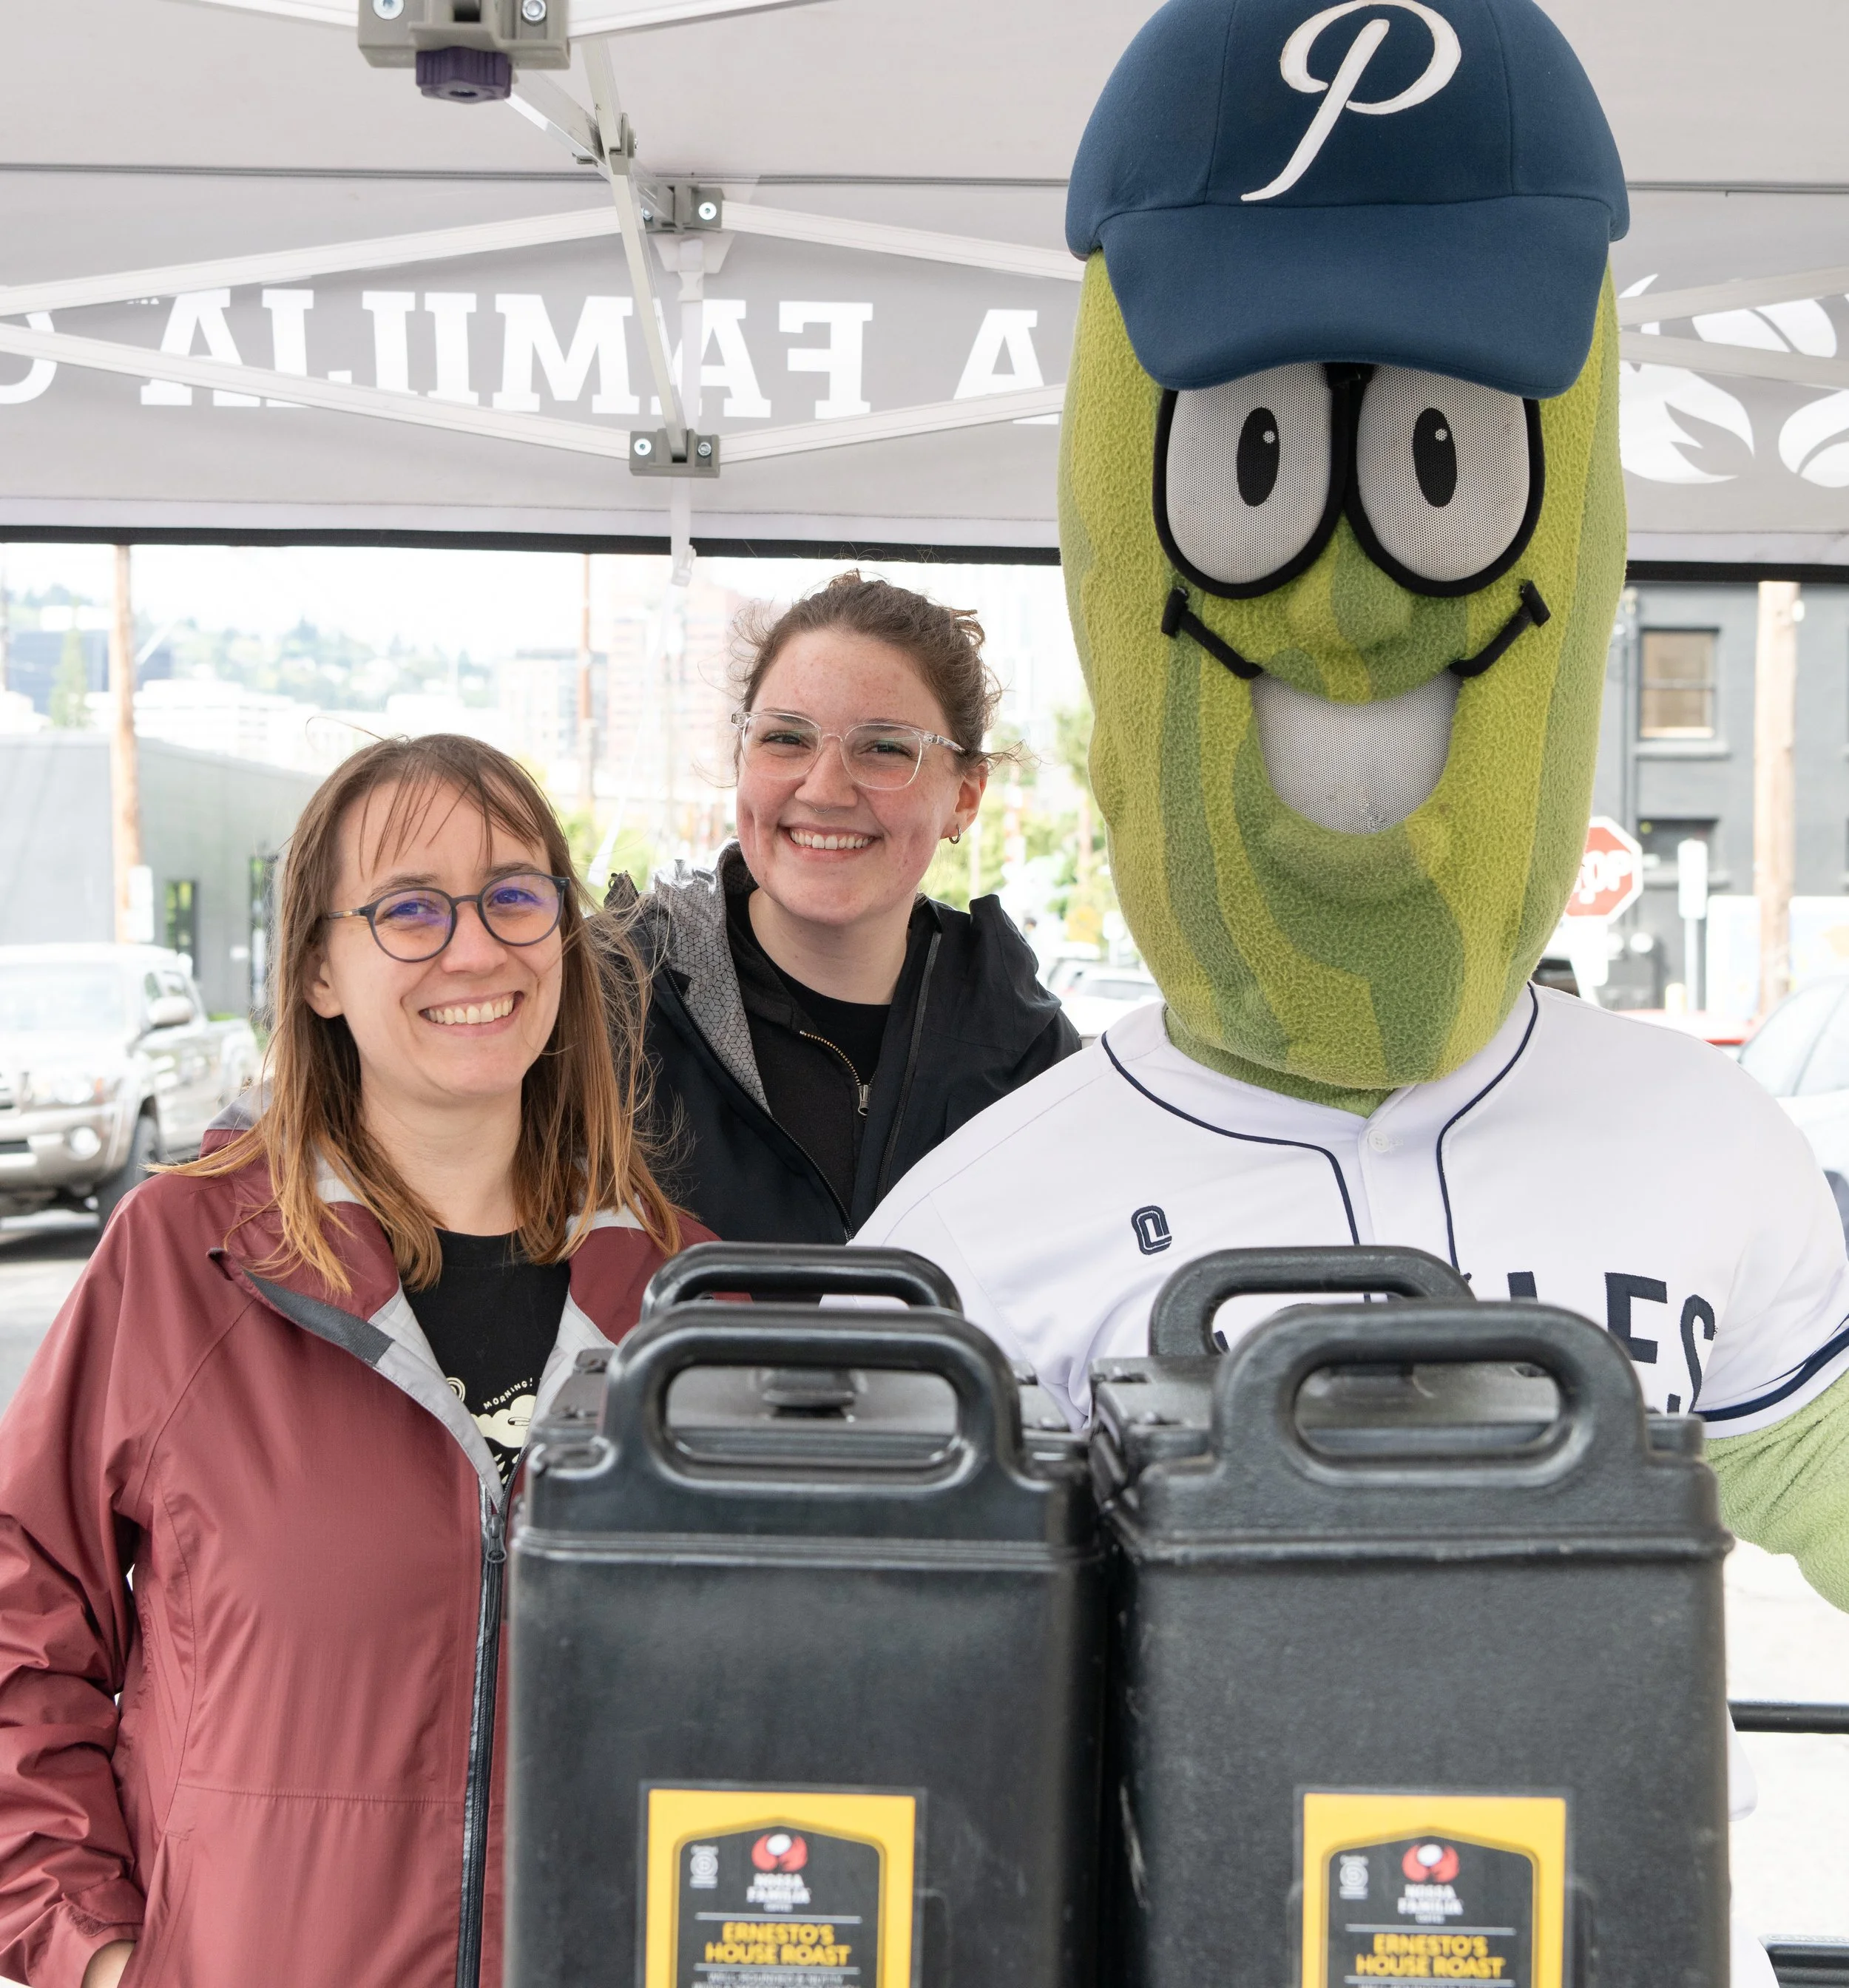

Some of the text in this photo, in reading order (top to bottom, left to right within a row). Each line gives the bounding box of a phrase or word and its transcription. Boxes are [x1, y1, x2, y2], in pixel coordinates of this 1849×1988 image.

[1241, 0, 1462, 202] P
[483, 1377, 533, 1410] MORNING!
[722, 1921, 835, 1946] ERNESTO'S
[1373, 1933, 1489, 1958] ERNESTO'S
[704, 1941, 852, 1967] HOUSE ROAST
[1355, 1953, 1507, 1980] HOUSE ROAST
